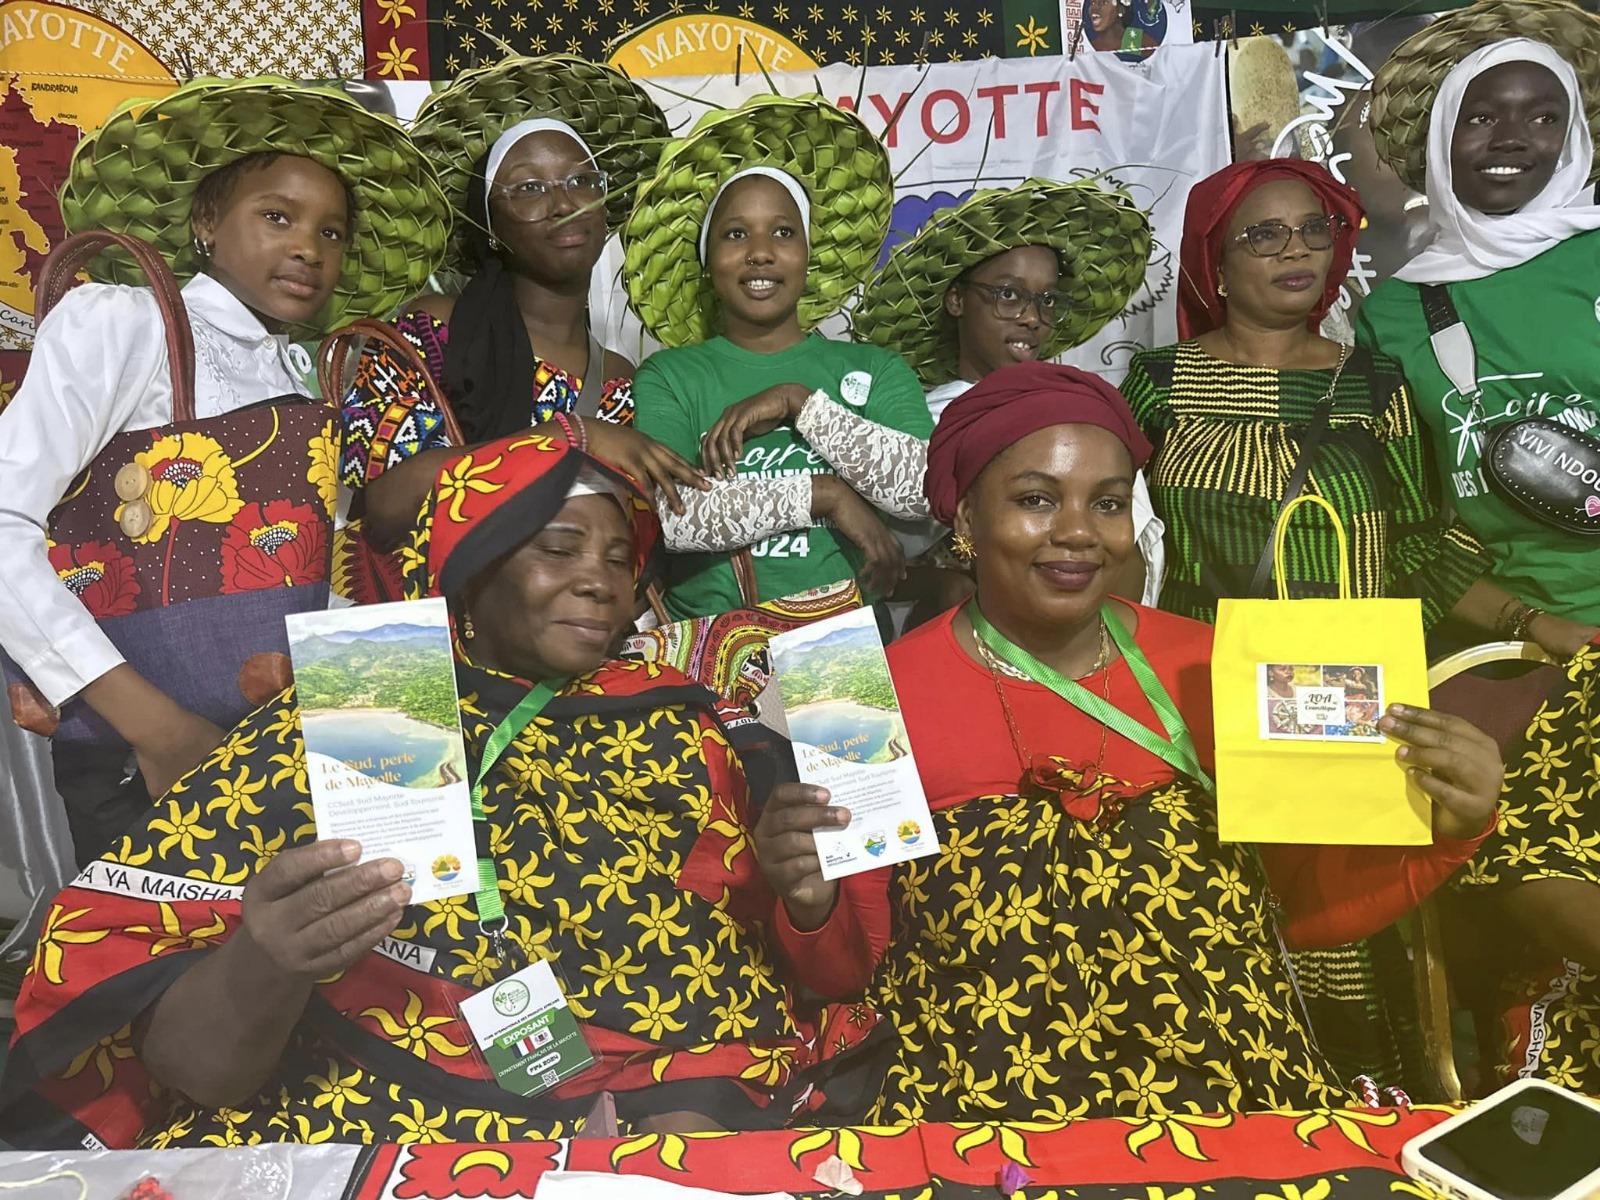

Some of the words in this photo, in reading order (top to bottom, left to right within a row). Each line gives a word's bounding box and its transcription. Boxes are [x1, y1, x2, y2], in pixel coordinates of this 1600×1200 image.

[0, 9, 135, 73] AYOTTE
[636, 24, 794, 71] MAYOTTE
[735, 443, 826, 470] oire
[1518, 430, 1554, 460] VIVI
[1452, 472, 1478, 498] DES
[750, 534, 810, 558] 024
[802, 747, 815, 758] Le
[842, 733, 870, 749] perle
[321, 760, 340, 774] Le
[379, 751, 416, 769] perle
[805, 760, 818, 772] de
[820, 749, 862, 770] Mayotte
[324, 778, 342, 791] de
[346, 769, 402, 791] Mayotte
[105, 867, 130, 890] YA
[141, 875, 232, 901] MAISHA
[502, 1014, 550, 1044] EXPOSANT
[542, 1053, 558, 1065] 2024
